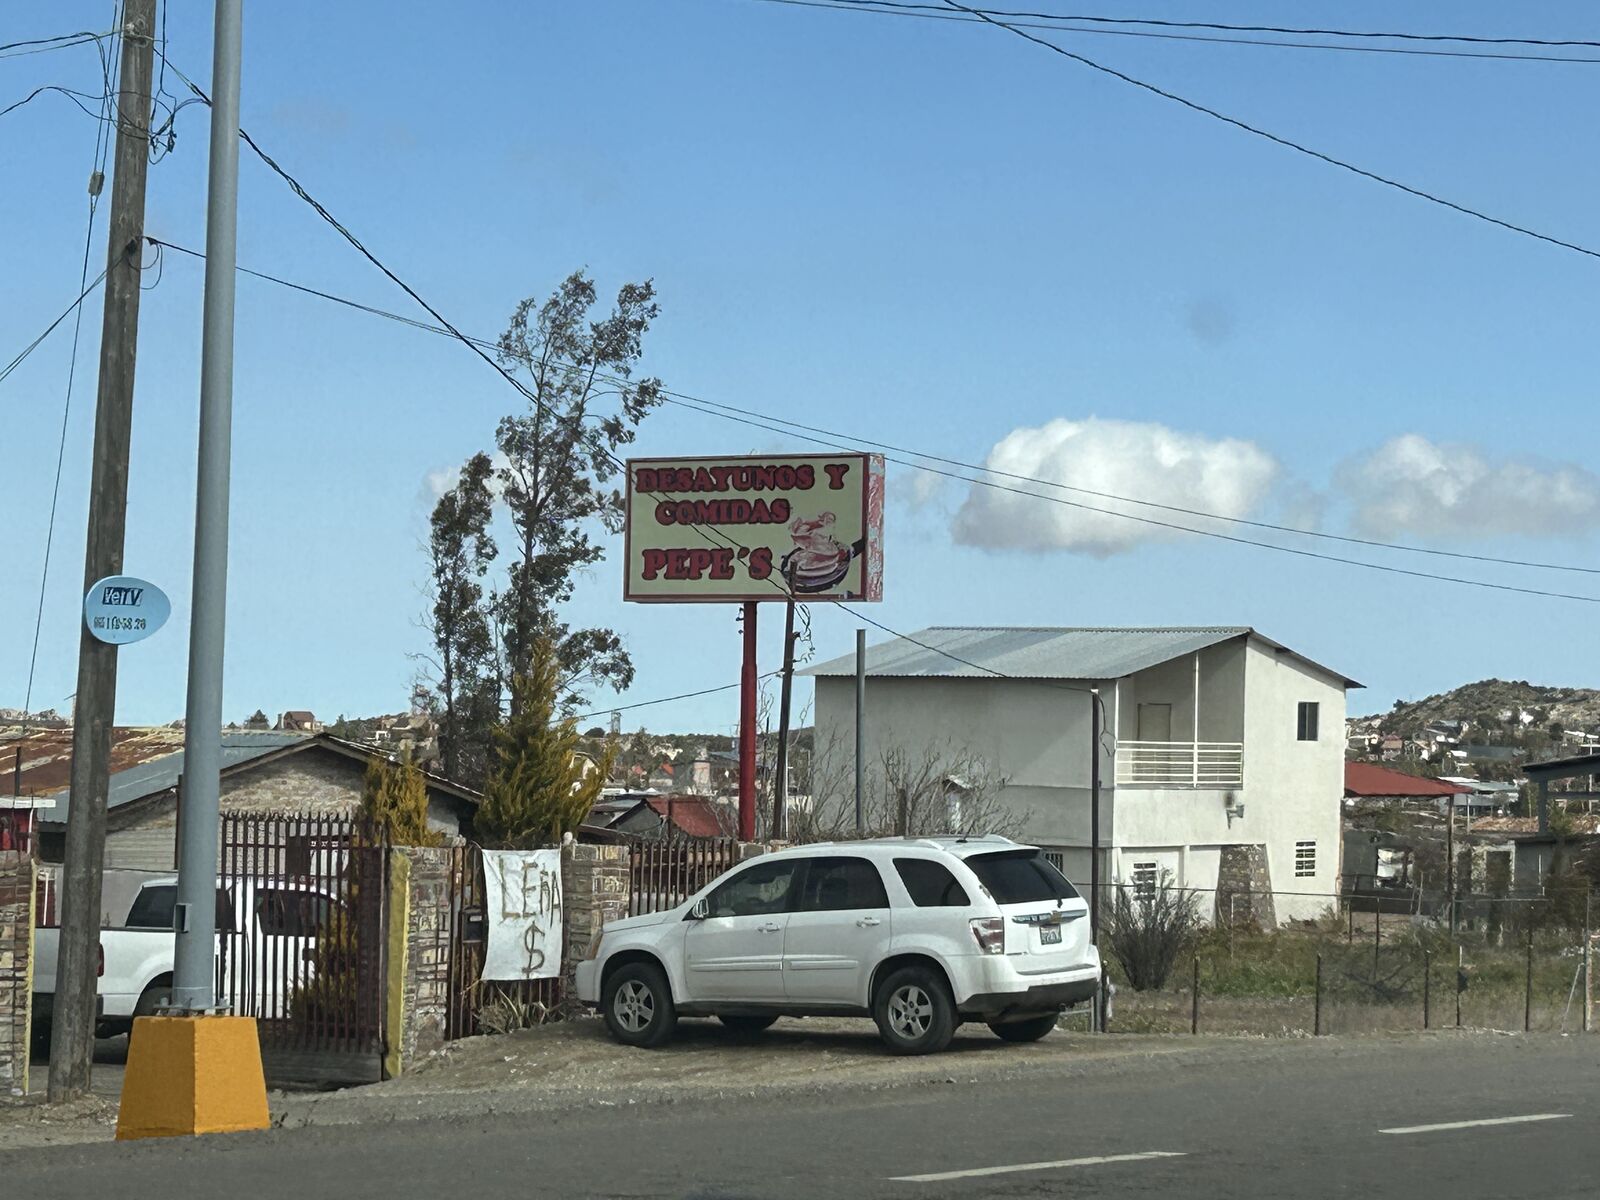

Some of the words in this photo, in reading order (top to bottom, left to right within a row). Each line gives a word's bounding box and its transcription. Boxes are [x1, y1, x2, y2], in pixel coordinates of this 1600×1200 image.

[635, 464, 815, 493] DESAYUNOS
[824, 464, 849, 490] Y
[655, 498, 791, 526] COMIDAS
[642, 547, 773, 580] PEPE'S
